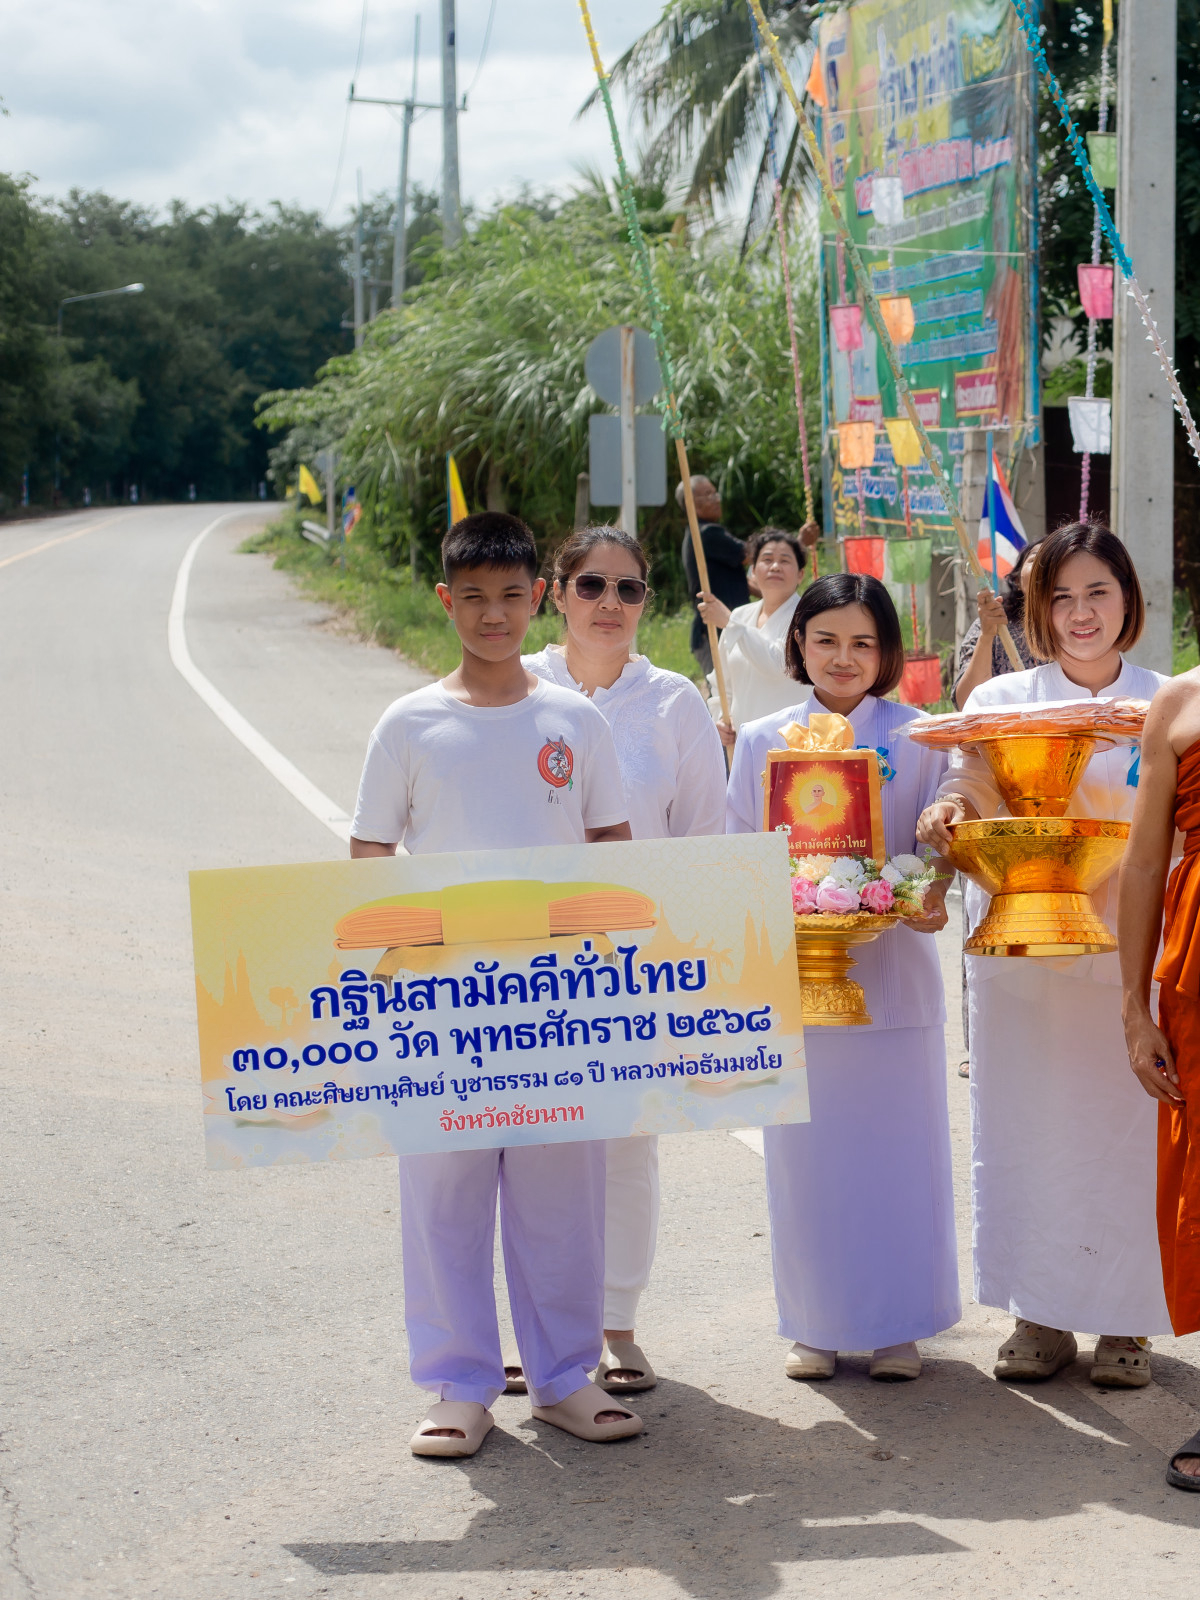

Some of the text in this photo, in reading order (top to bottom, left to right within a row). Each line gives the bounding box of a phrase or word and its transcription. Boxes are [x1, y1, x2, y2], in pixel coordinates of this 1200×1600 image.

[309, 941, 706, 1031] กฐินสามัคคีทั่วไทย
[232, 1005, 772, 1074] ๓๐,๐๐๐ วัด พุทธศักราช ๒๕๖๘
[225, 1046, 782, 1112] โดย คณะศิษยานุศิษย์ บูชาธรรม ๘๑ ปี หลวงพ่อธัมมชโย
[439, 1103, 585, 1132] จังหวัดชัยนาท
